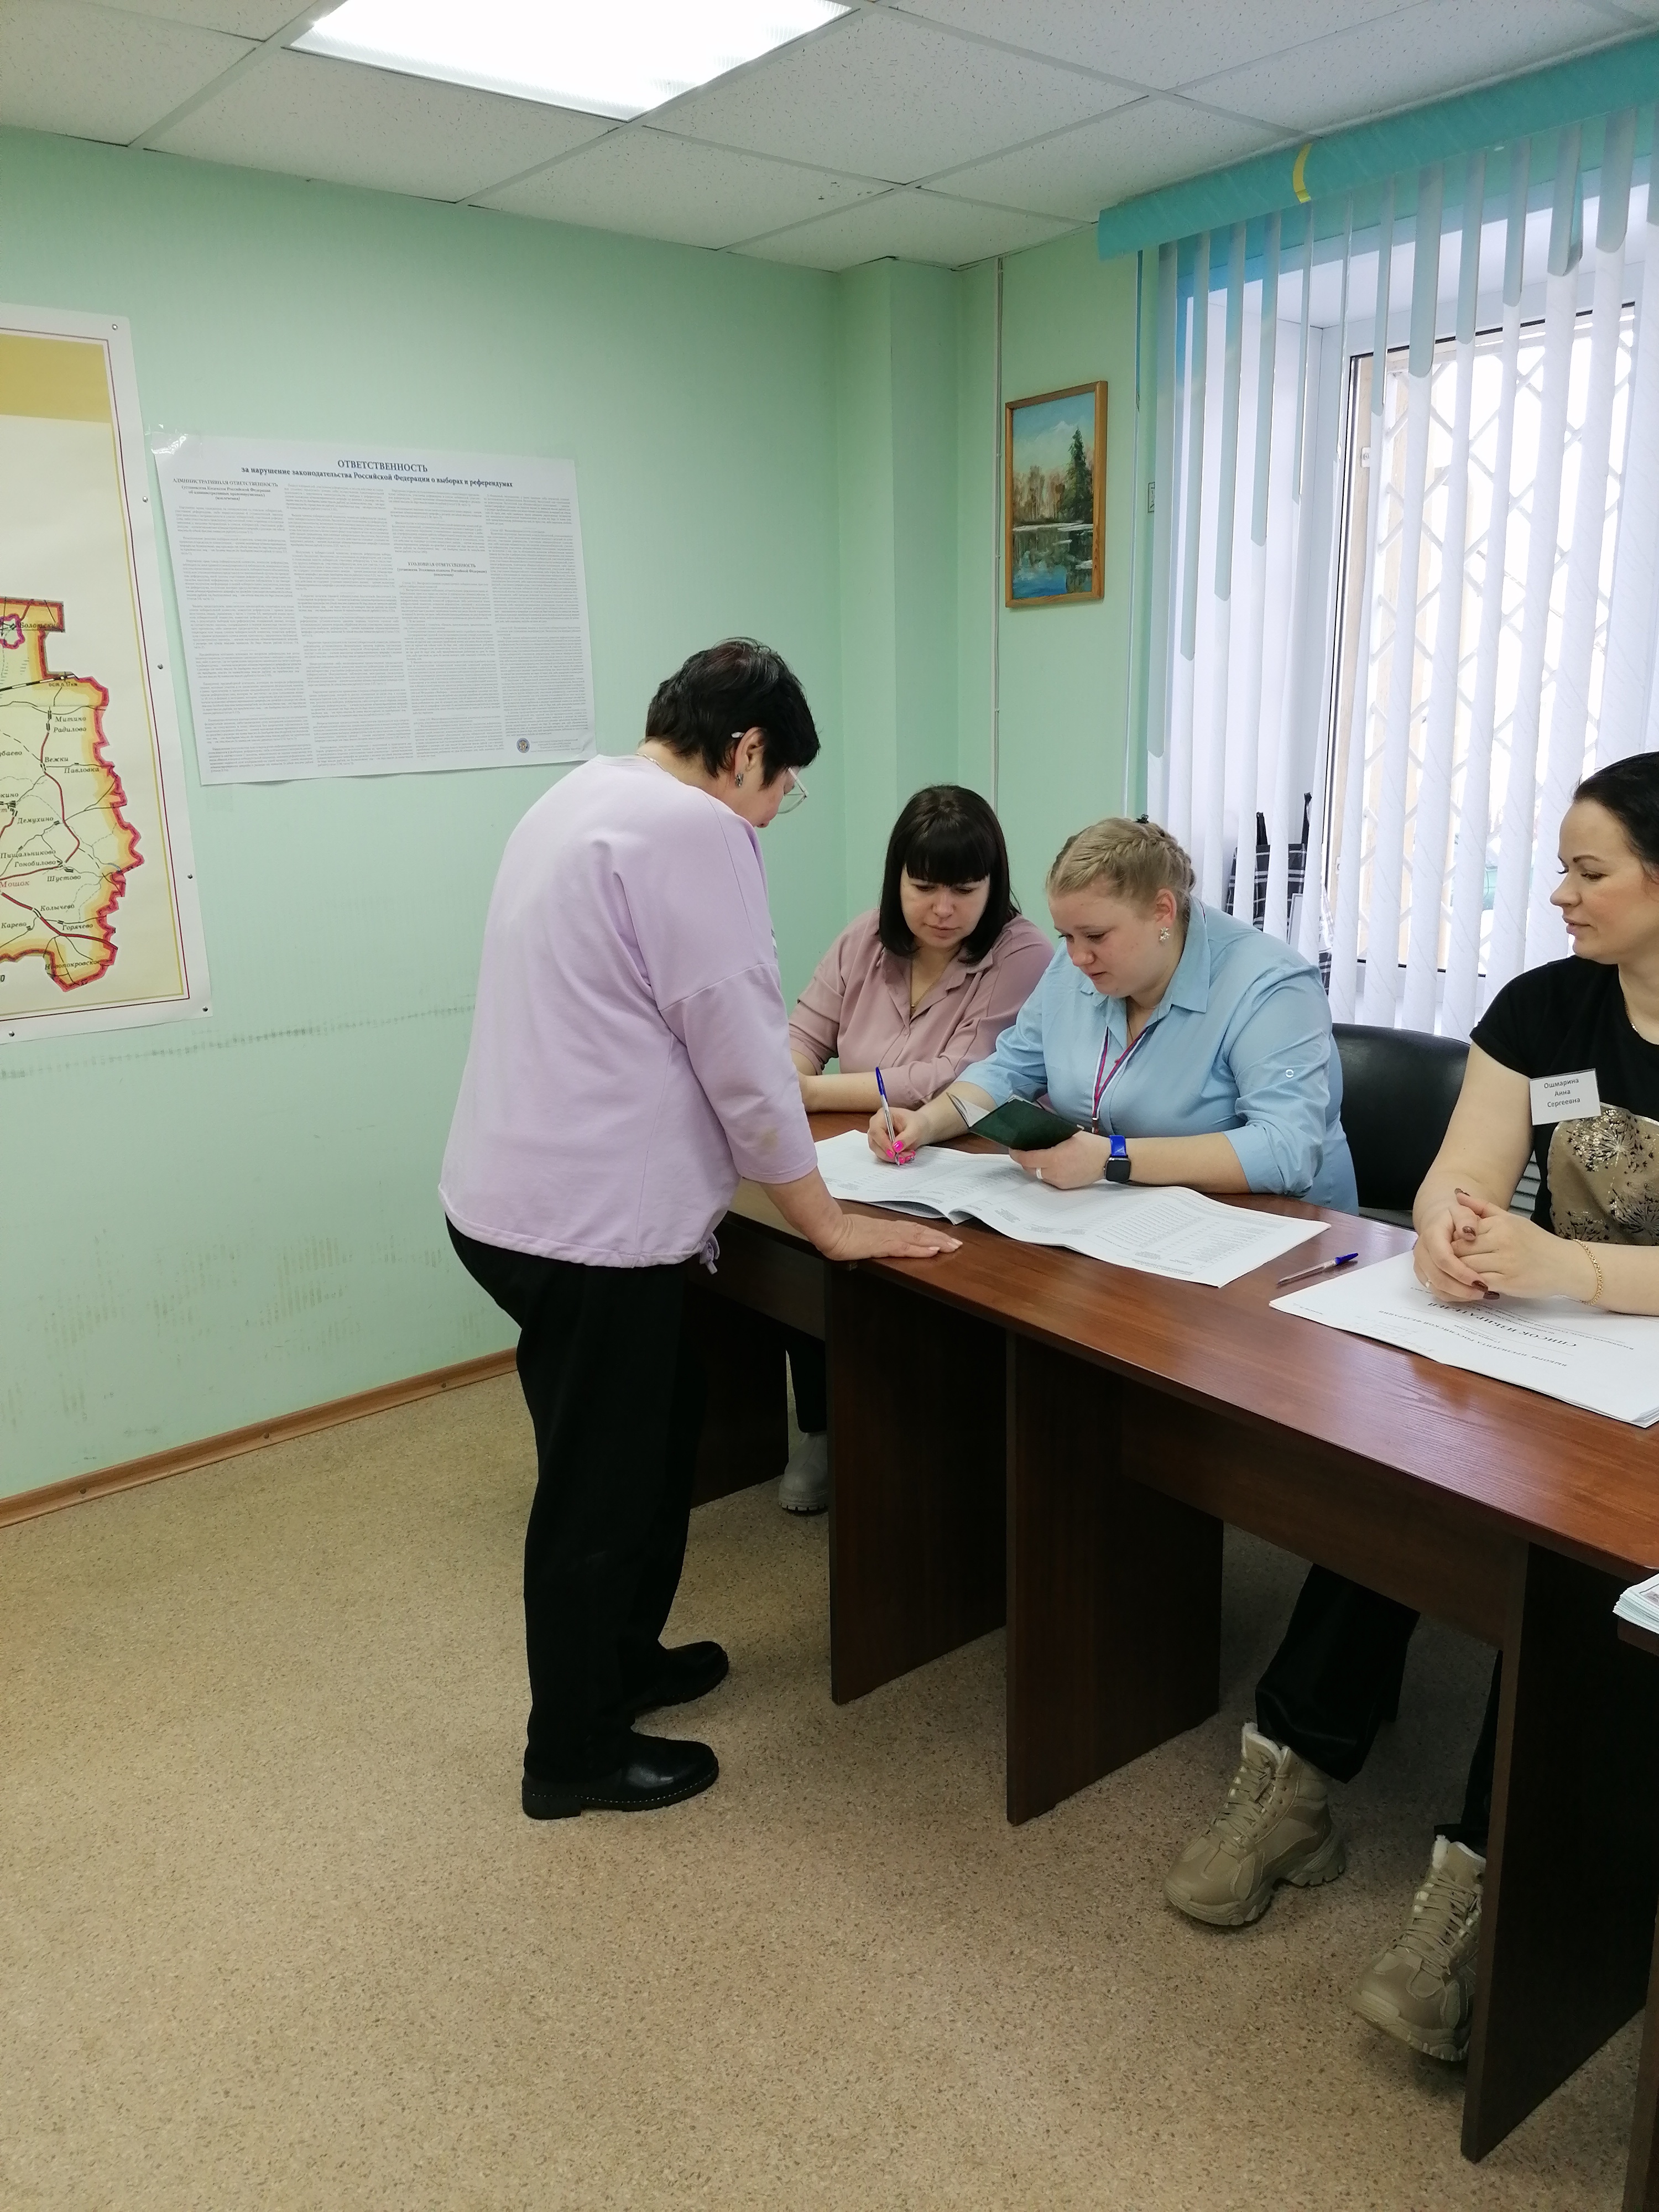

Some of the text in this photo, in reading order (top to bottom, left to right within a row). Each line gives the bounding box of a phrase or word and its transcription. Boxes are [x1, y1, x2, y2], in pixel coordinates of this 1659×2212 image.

[337, 460, 428, 473] ОТВЕТСТВЕННОСТЬ
[251, 467, 290, 476] нарушение
[292, 468, 352, 479] законодательства
[354, 472, 392, 481] Российской
[394, 474, 430, 484] Федерации
[436, 476, 463, 486] выборах
[469, 478, 513, 488] референдумах
[1, 850, 56, 858] Пищальниково
[1544, 1078, 1579, 1089] Ошмарина
[1547, 1098, 1580, 1108] Сергеевна
[1428, 1302, 1516, 1333] ИЗБИРАТЕЛЕЙ
[1519, 1330, 1577, 1347] СПИСОК
